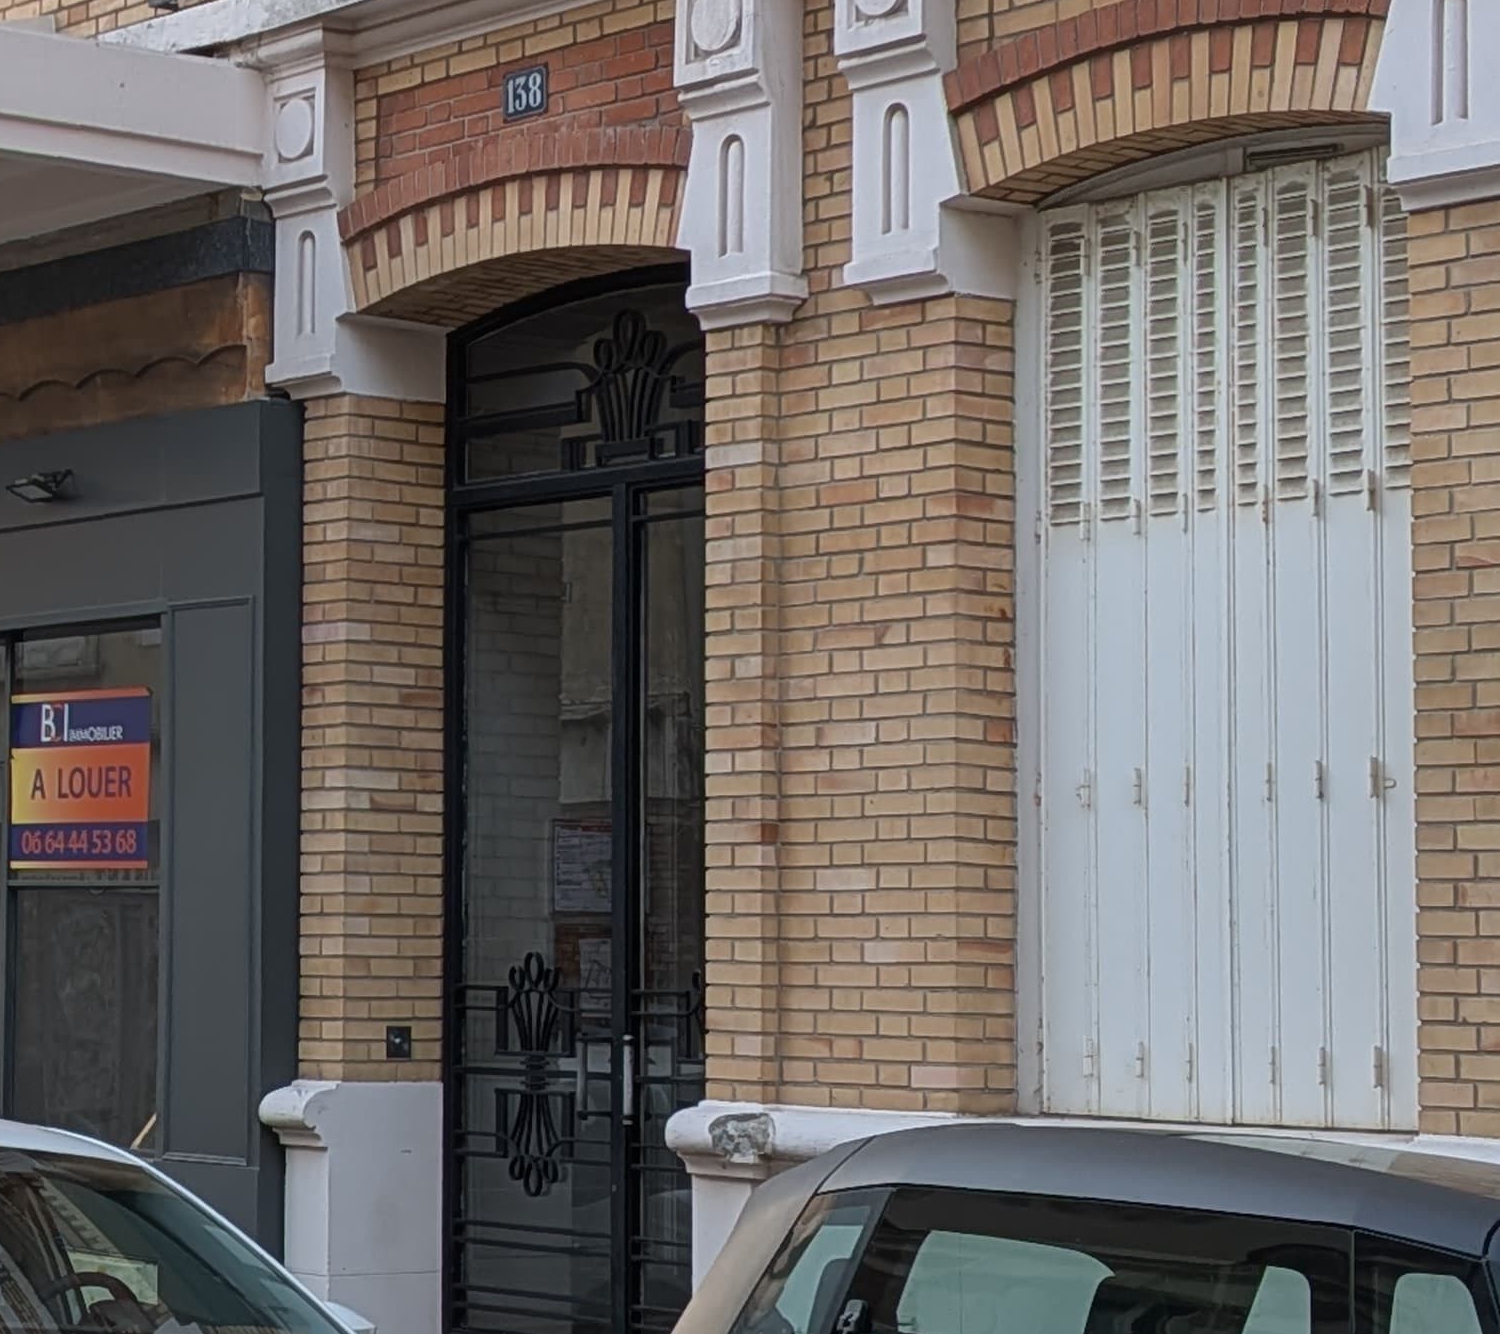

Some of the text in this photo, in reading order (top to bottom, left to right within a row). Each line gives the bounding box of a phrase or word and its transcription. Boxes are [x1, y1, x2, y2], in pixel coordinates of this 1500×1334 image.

[507, 72, 542, 114] 138
[30, 765, 132, 800] A LOUER
[21, 829, 137, 854] 06 64 44 53 68
